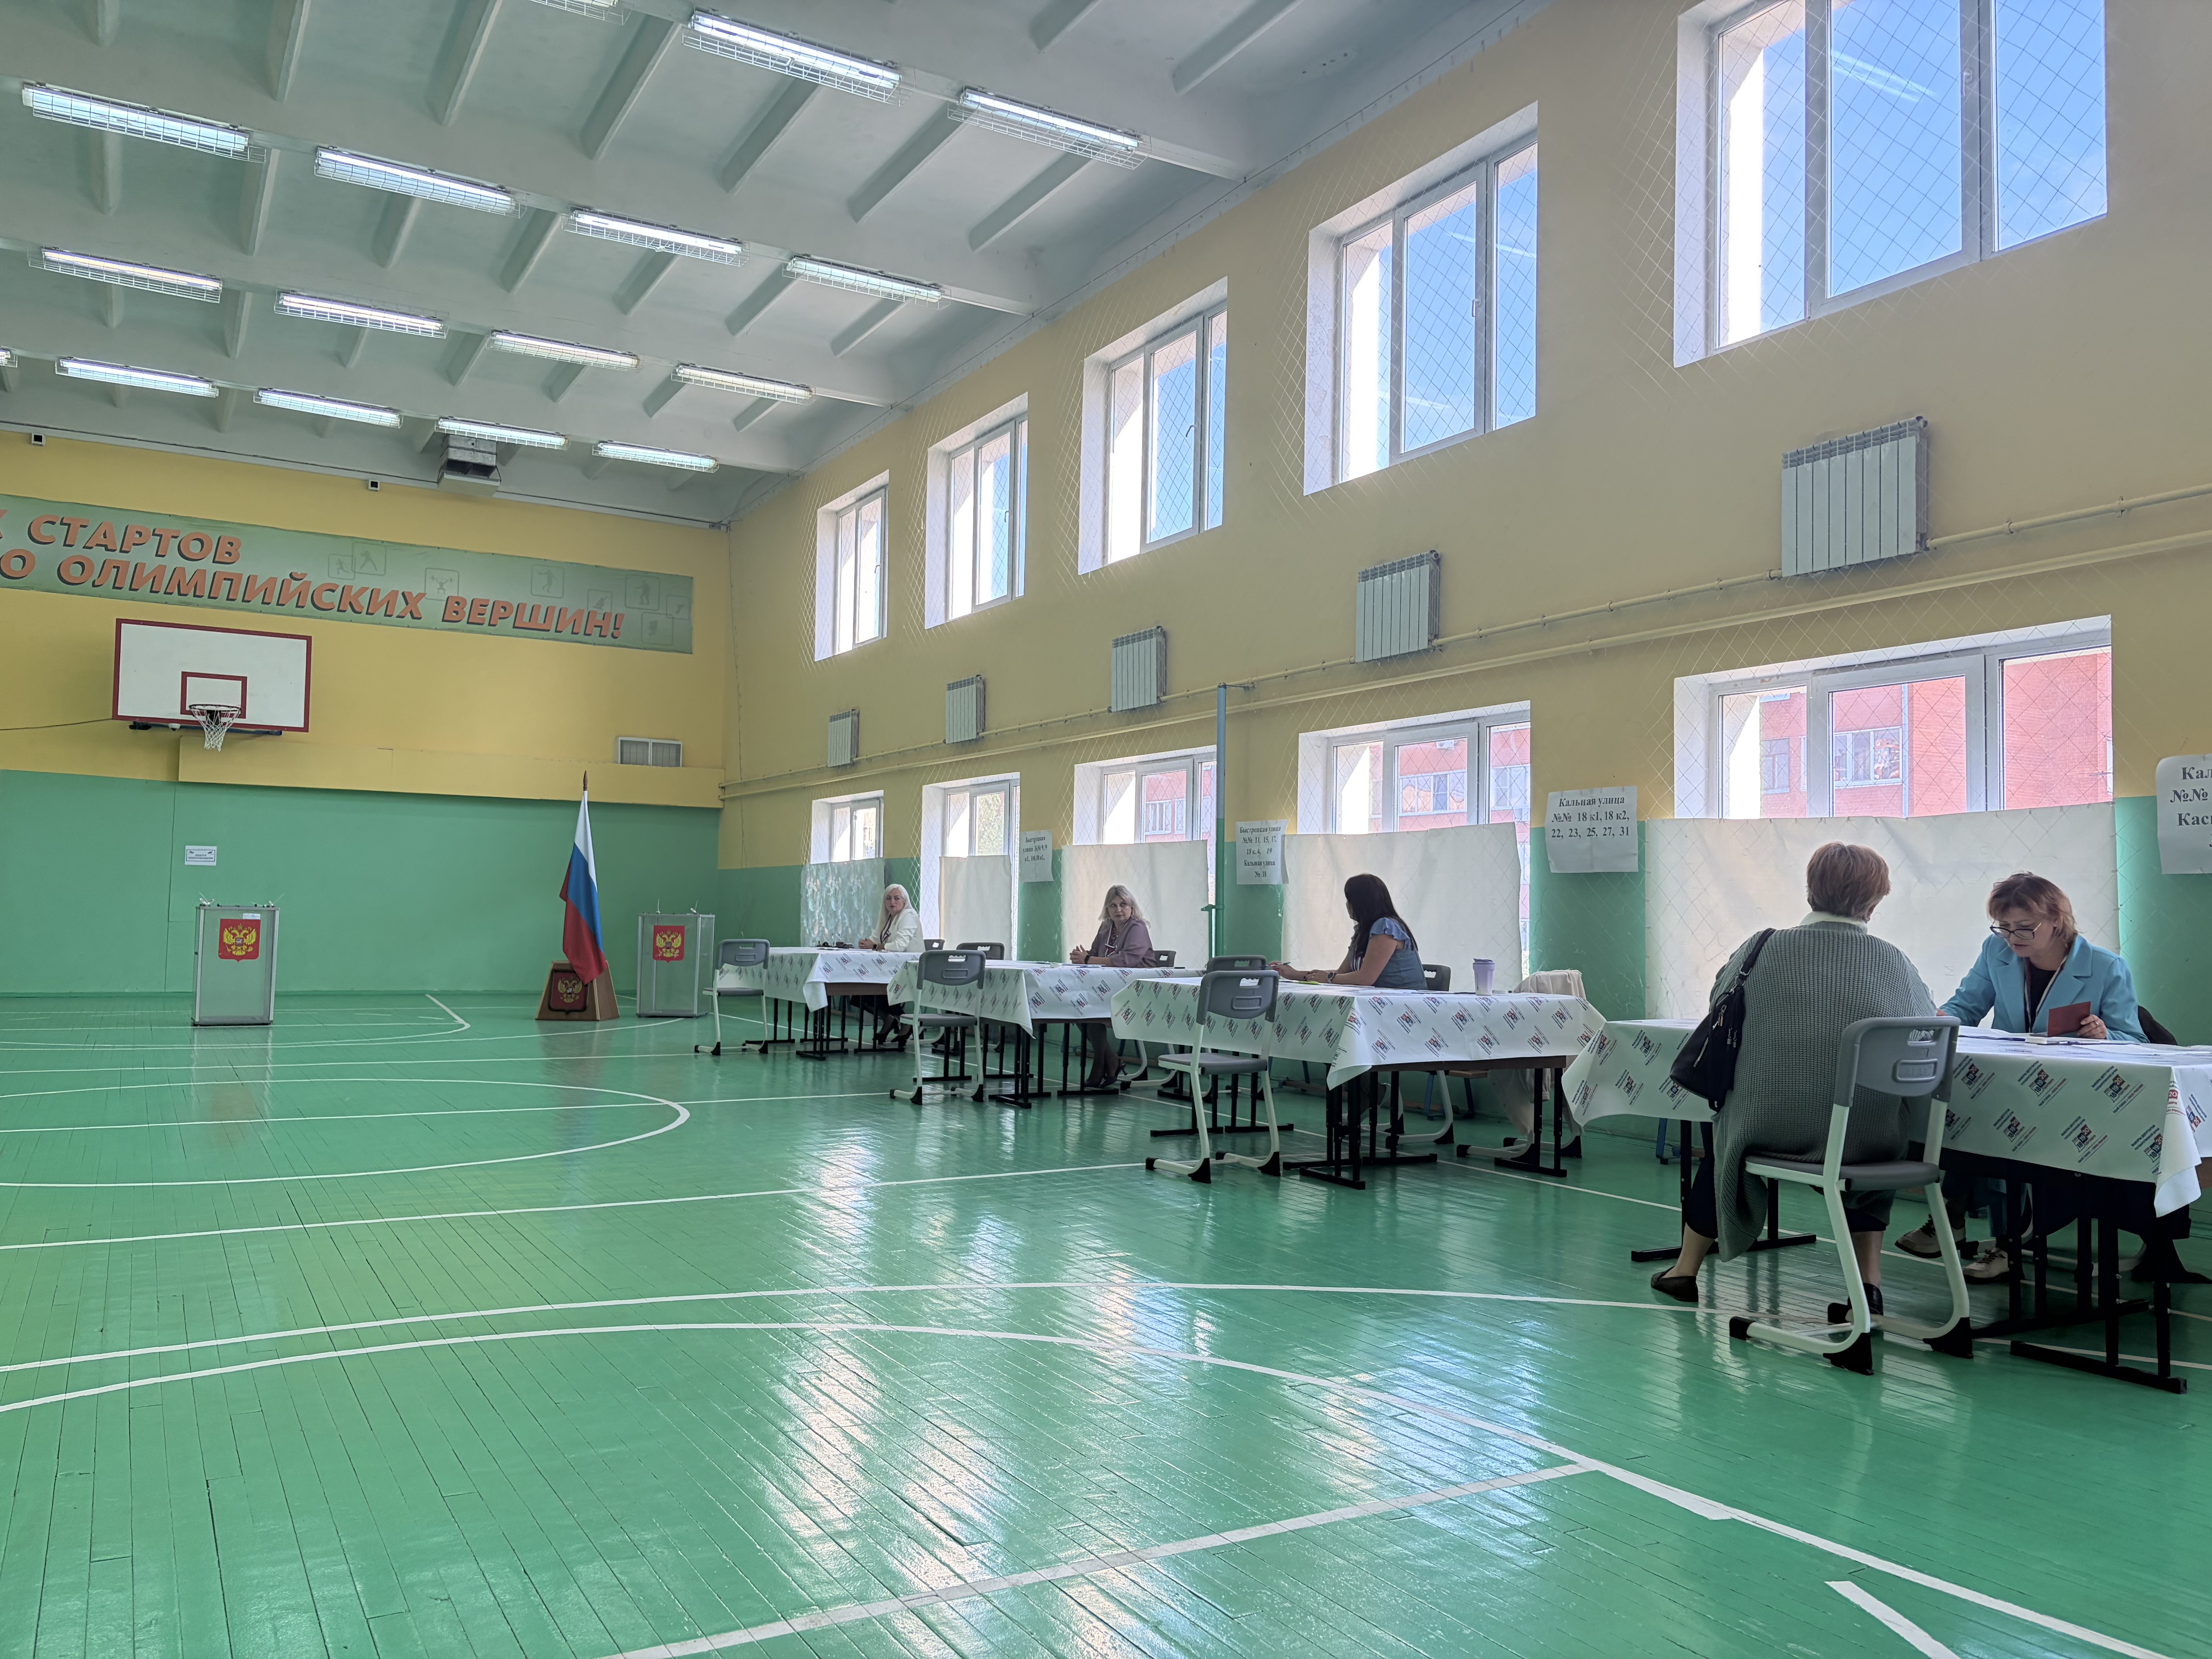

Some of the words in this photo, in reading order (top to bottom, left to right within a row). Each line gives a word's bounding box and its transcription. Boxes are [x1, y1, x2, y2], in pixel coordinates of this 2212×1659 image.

[27, 514, 241, 565] СТАРТОВ
[57, 555, 426, 620] ОЛИМПИЙСКИХ
[442, 595, 625, 639] ВЕРШИН!
[1559, 797, 1596, 807] Кальная
[1598, 796, 1625, 807] улица
[2170, 788, 2208, 803] №№
[1551, 813, 1572, 823] №№
[1577, 812, 1587, 822] 18
[1590, 812, 1602, 822] к1,
[1604, 811, 1614, 821] 18
[1616, 811, 1630, 821] к2,
[1551, 829, 1564, 840] 22,
[1568, 828, 1581, 839] 23,
[1587, 828, 1598, 838] 25,
[1602, 827, 1615, 838] 27,
[1620, 826, 1630, 836] 31
